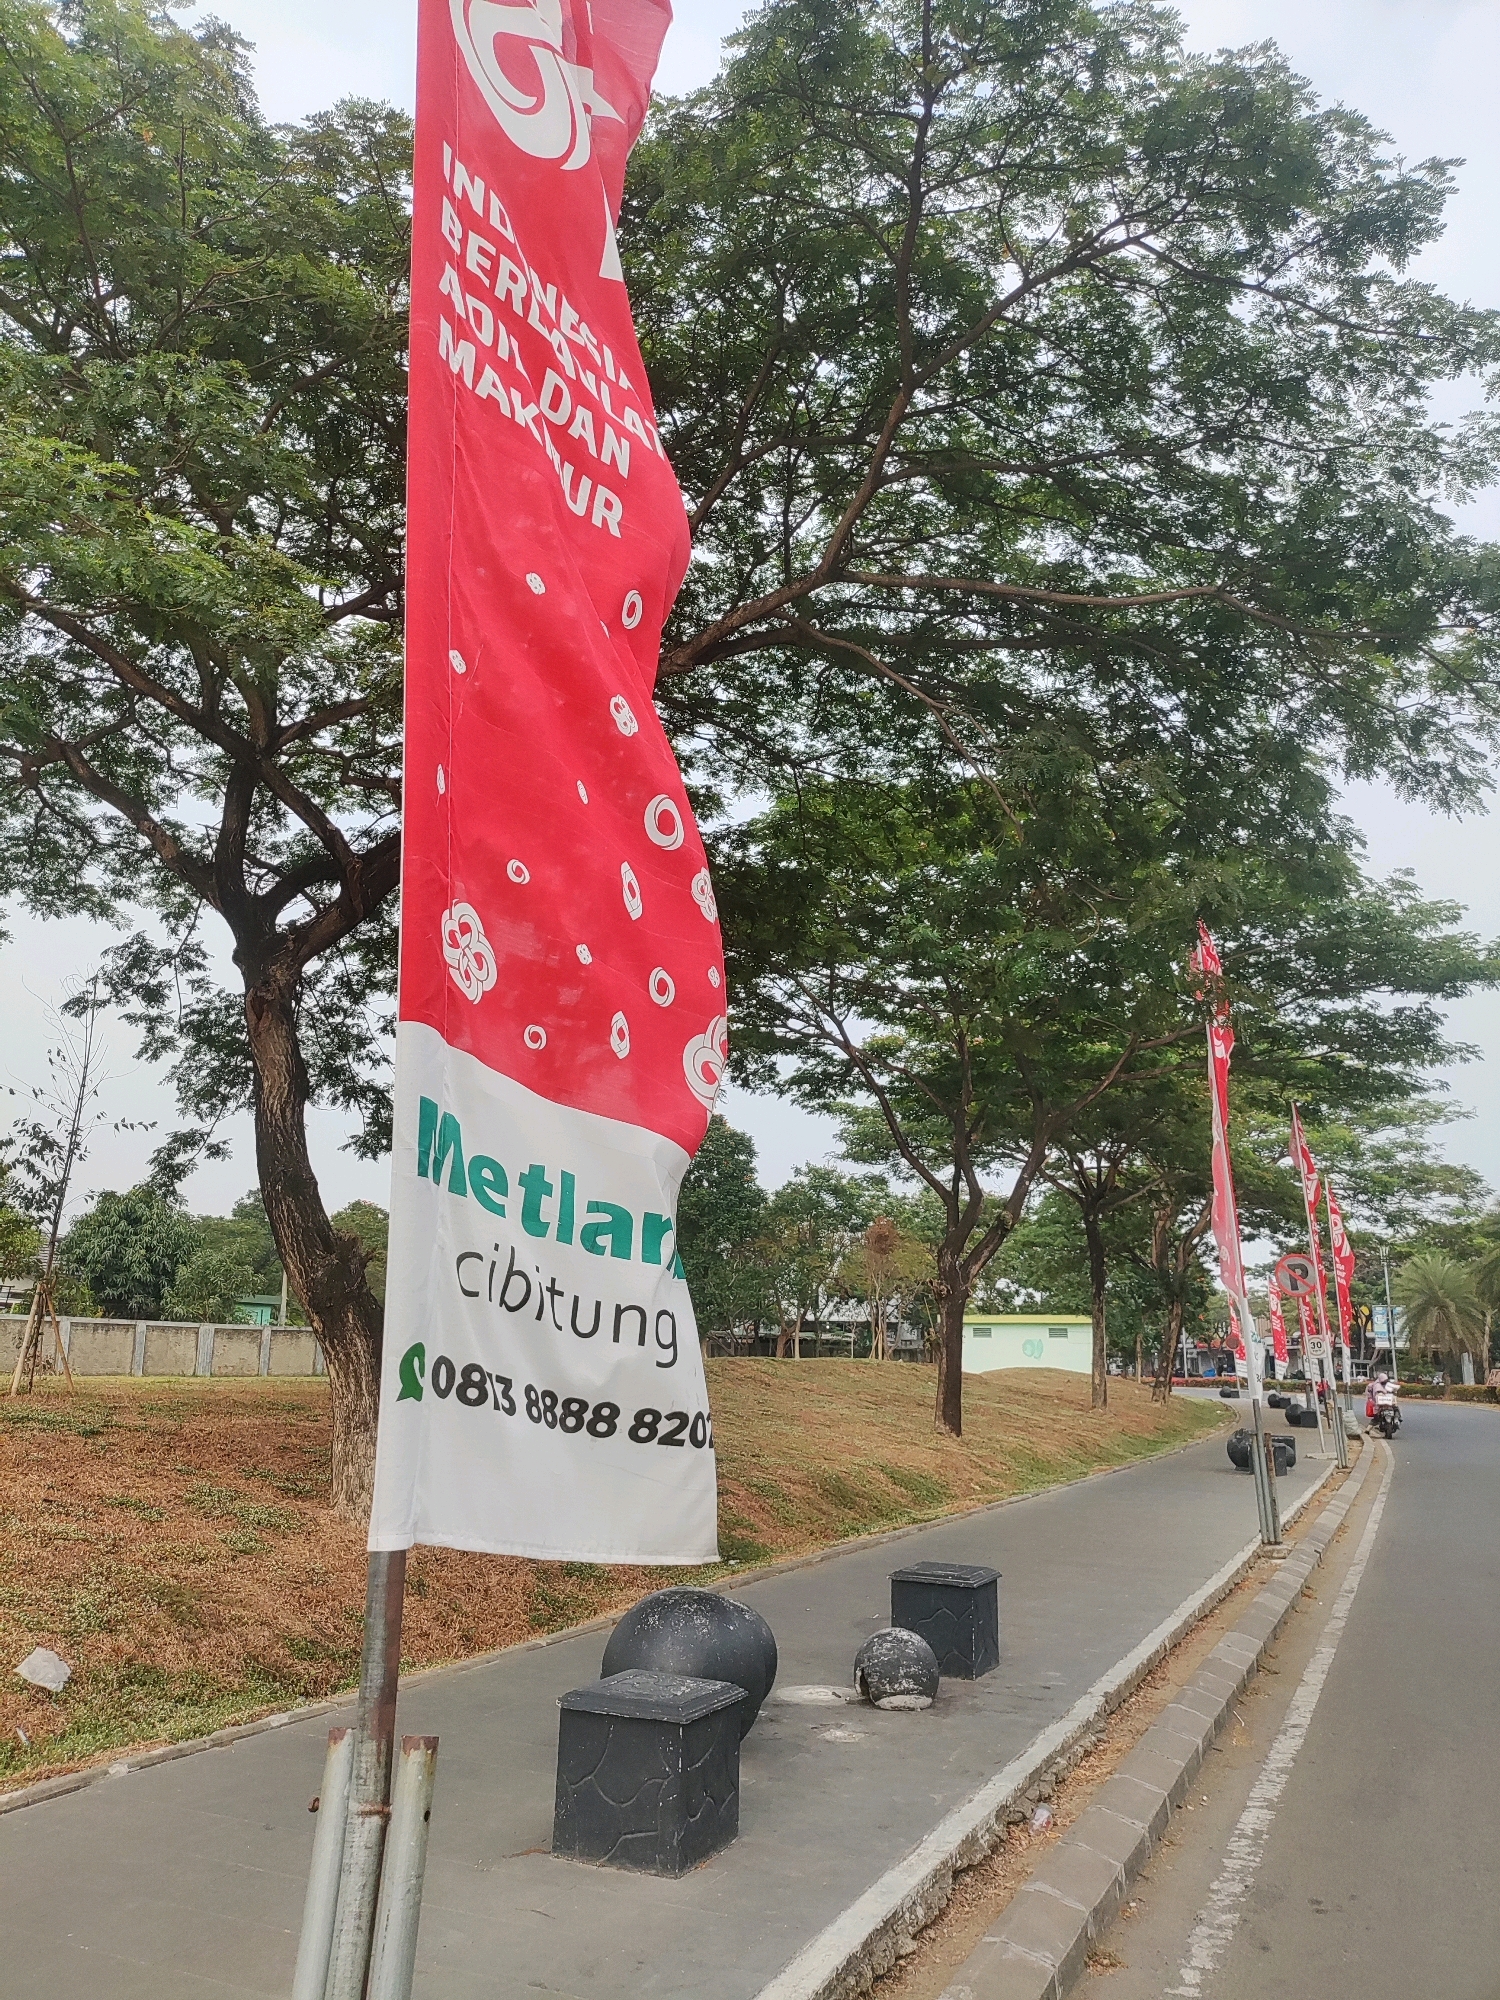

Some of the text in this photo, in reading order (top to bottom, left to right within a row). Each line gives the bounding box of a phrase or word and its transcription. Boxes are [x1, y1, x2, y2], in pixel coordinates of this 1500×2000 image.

[443, 140, 640, 402] INDNESIA
[540, 367, 630, 480] DAN
[417, 1095, 686, 1280] Metlan
[455, 1242, 678, 1369] cibitung
[1310, 1341, 1322, 1350] 30
[431, 1355, 517, 1417] 0813
[524, 1383, 620, 1439] 8888
